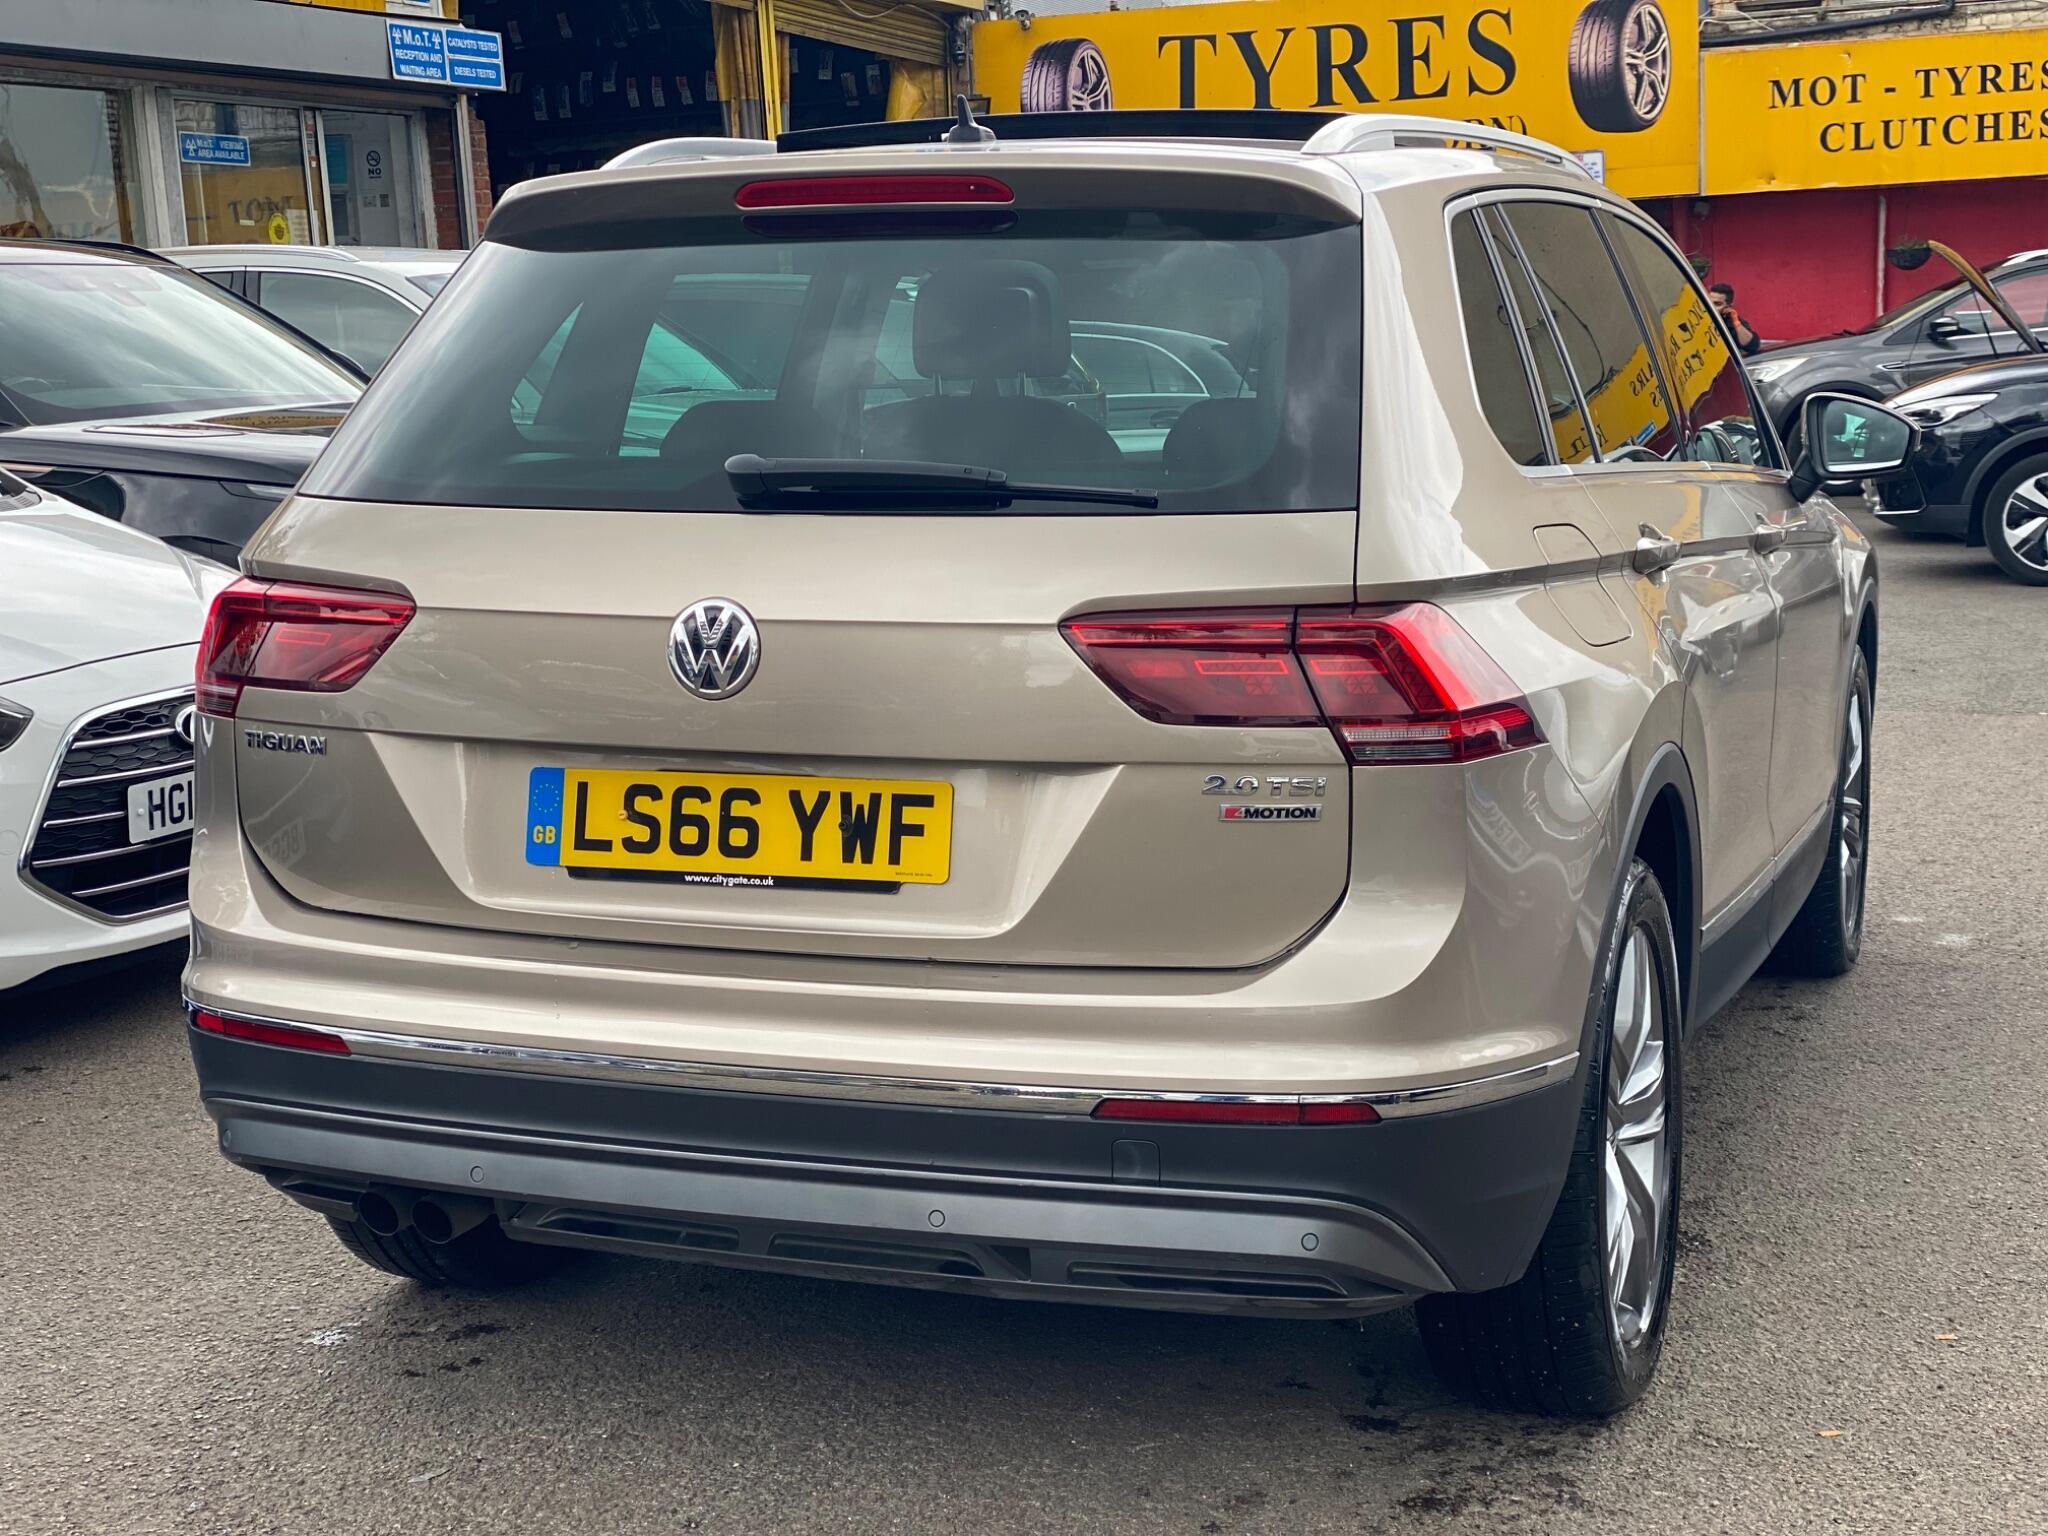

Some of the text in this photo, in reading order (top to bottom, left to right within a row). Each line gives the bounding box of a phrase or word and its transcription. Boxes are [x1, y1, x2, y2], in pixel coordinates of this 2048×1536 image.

[447, 37, 498, 52] CATALYSTS TESTED
[395, 48, 443, 64] RECEPTION AND
[1158, 8, 1517, 110] TYRES
[400, 64, 442, 78] WAITING AREA
[454, 66, 497, 79] DIESELS TESTED
[1768, 73, 1867, 110] MOT
[214, 150, 245, 160] AVAILABLE
[244, 729, 327, 756] TIGUAN
[573, 781, 936, 866] LS66 YWF
[533, 825, 556, 844] GB
[684, 874, 774, 887] www.citygate.co.uk
